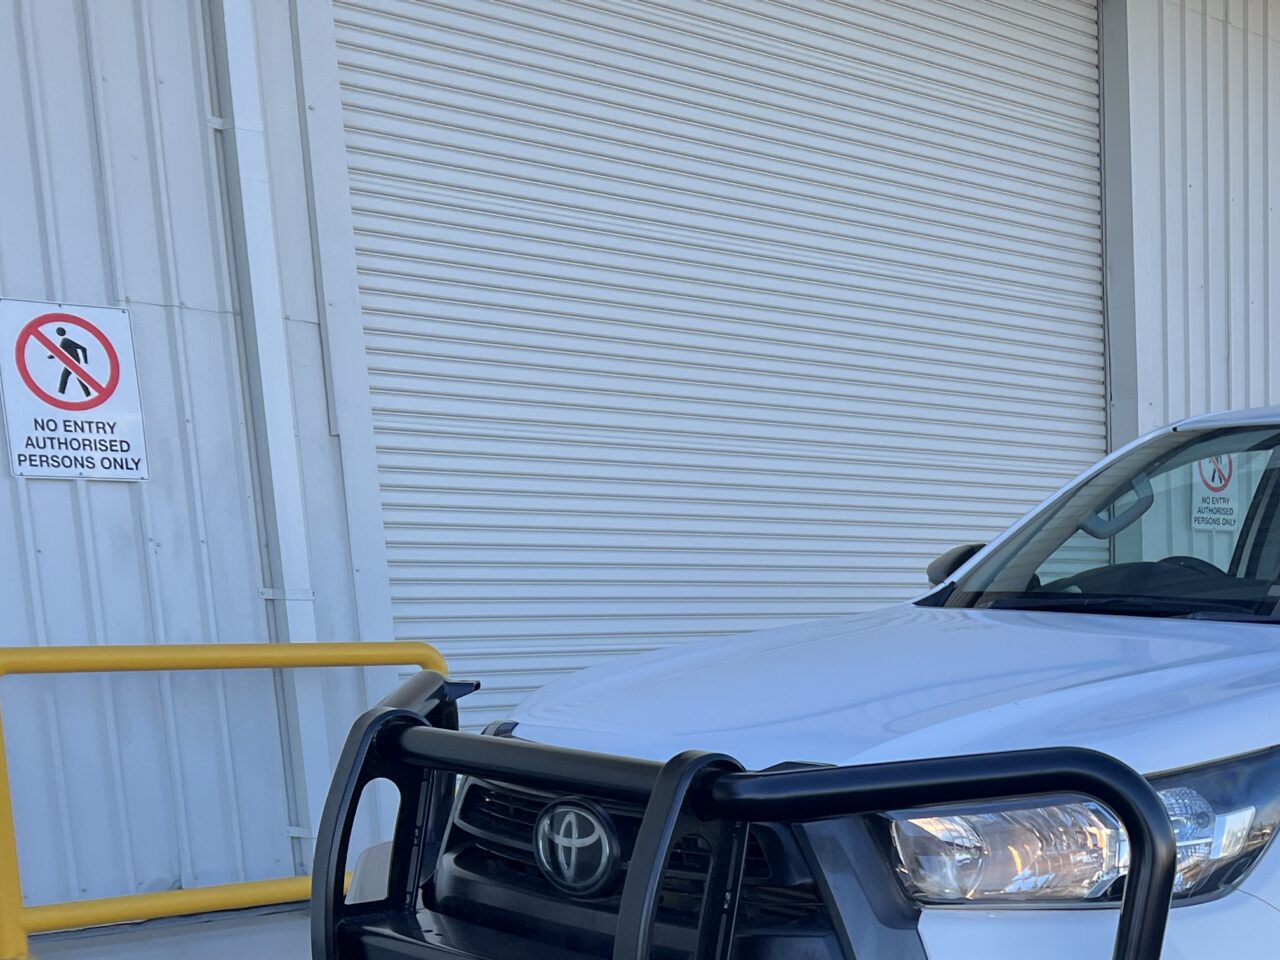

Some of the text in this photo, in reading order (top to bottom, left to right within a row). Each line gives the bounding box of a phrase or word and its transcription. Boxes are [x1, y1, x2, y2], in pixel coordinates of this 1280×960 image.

[34, 418, 117, 435] NO ENTRY
[25, 436, 131, 453] AUTHORISED
[17, 453, 141, 471] PERSONS ONLY
[1201, 496, 1230, 506] NO ENTRY
[1197, 506, 1234, 516] AUTHORISED
[1193, 516, 1237, 527] PERSONS ONLY
